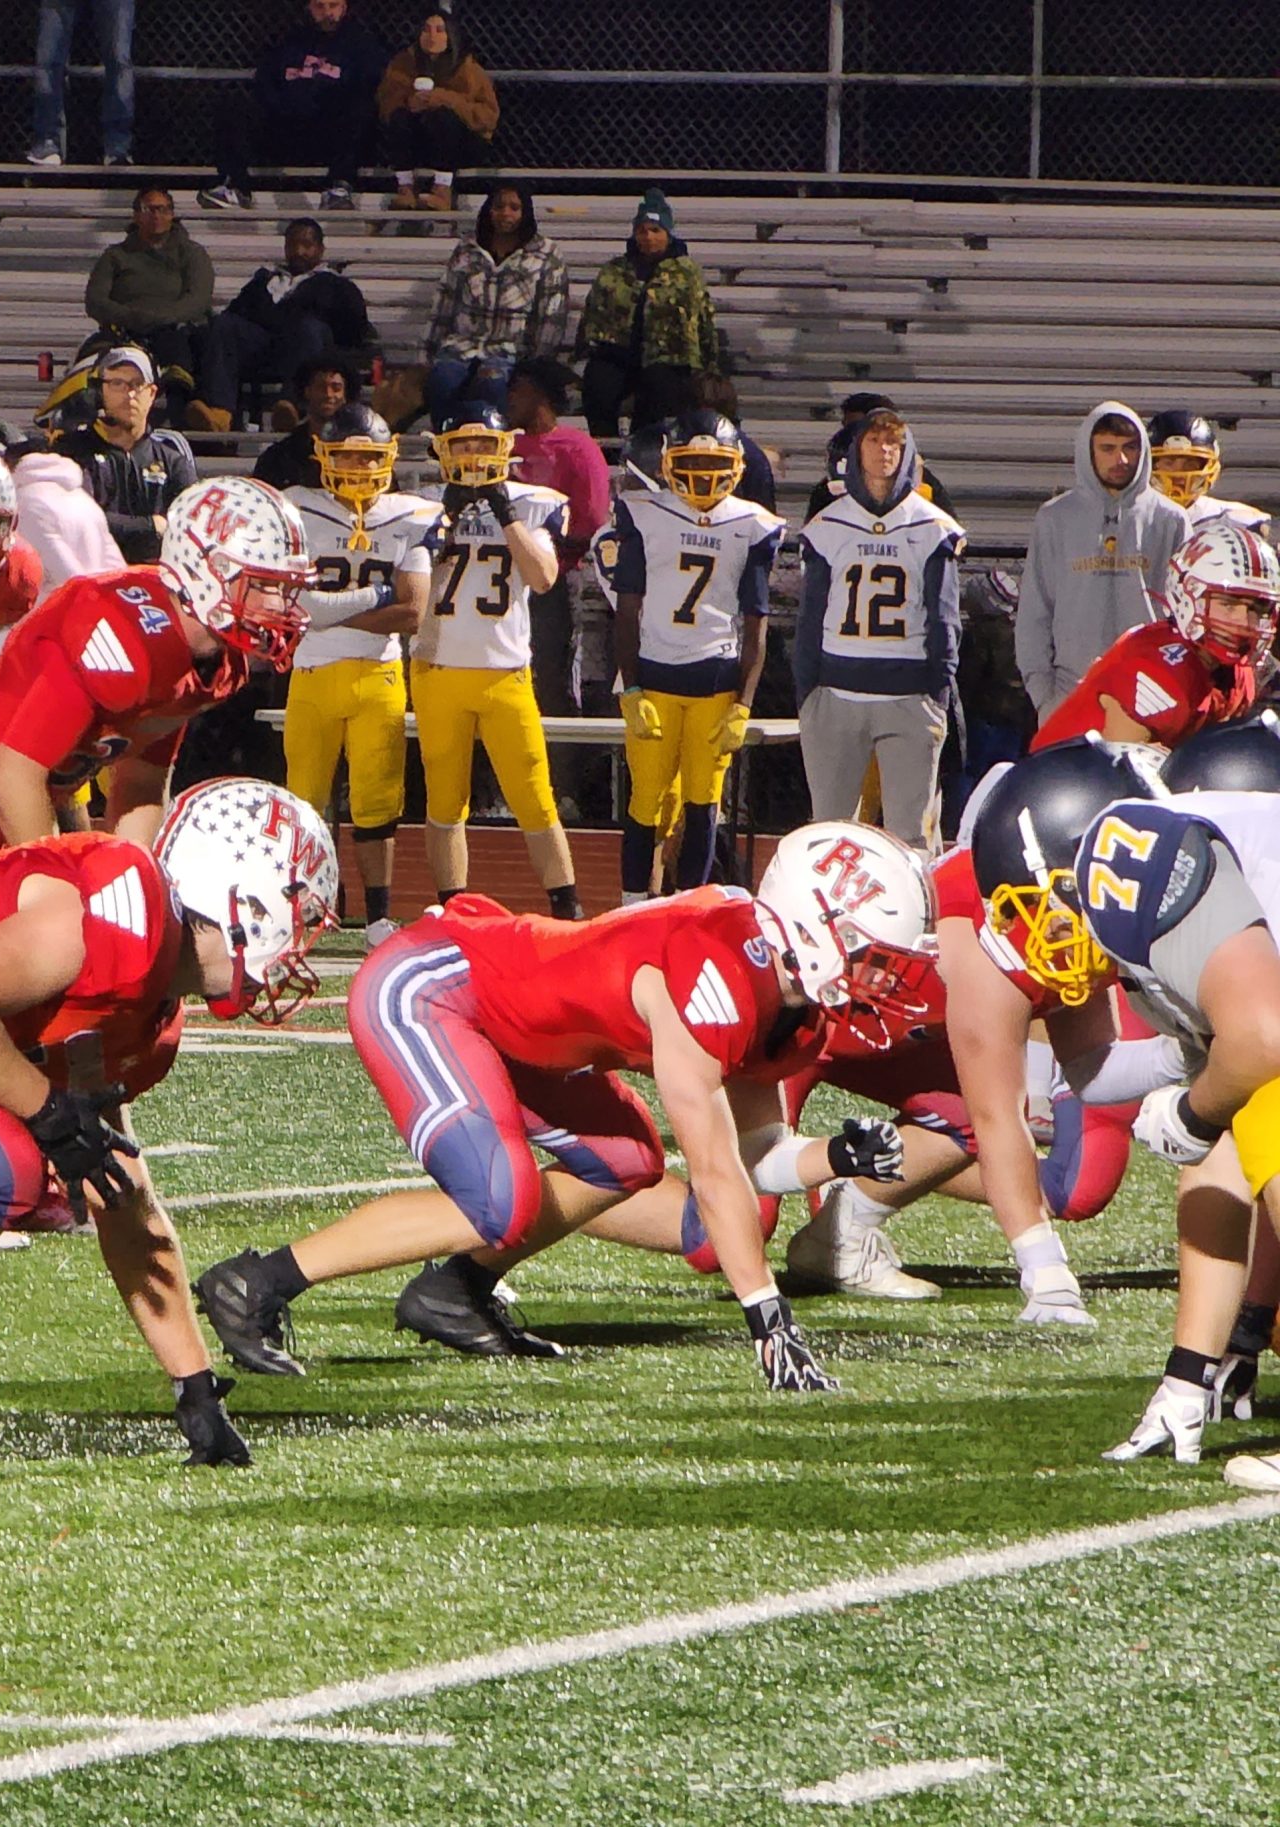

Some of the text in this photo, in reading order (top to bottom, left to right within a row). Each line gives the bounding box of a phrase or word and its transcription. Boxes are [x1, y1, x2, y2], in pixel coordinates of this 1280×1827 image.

[679, 532, 723, 550] TROJANS
[856, 543, 899, 558] TROJANS
[433, 542, 513, 617] 73
[672, 551, 716, 626] 7
[838, 563, 907, 639] 12
[1158, 643, 1189, 666] 4
[811, 833, 887, 913] RW
[1087, 815, 1160, 914] 77
